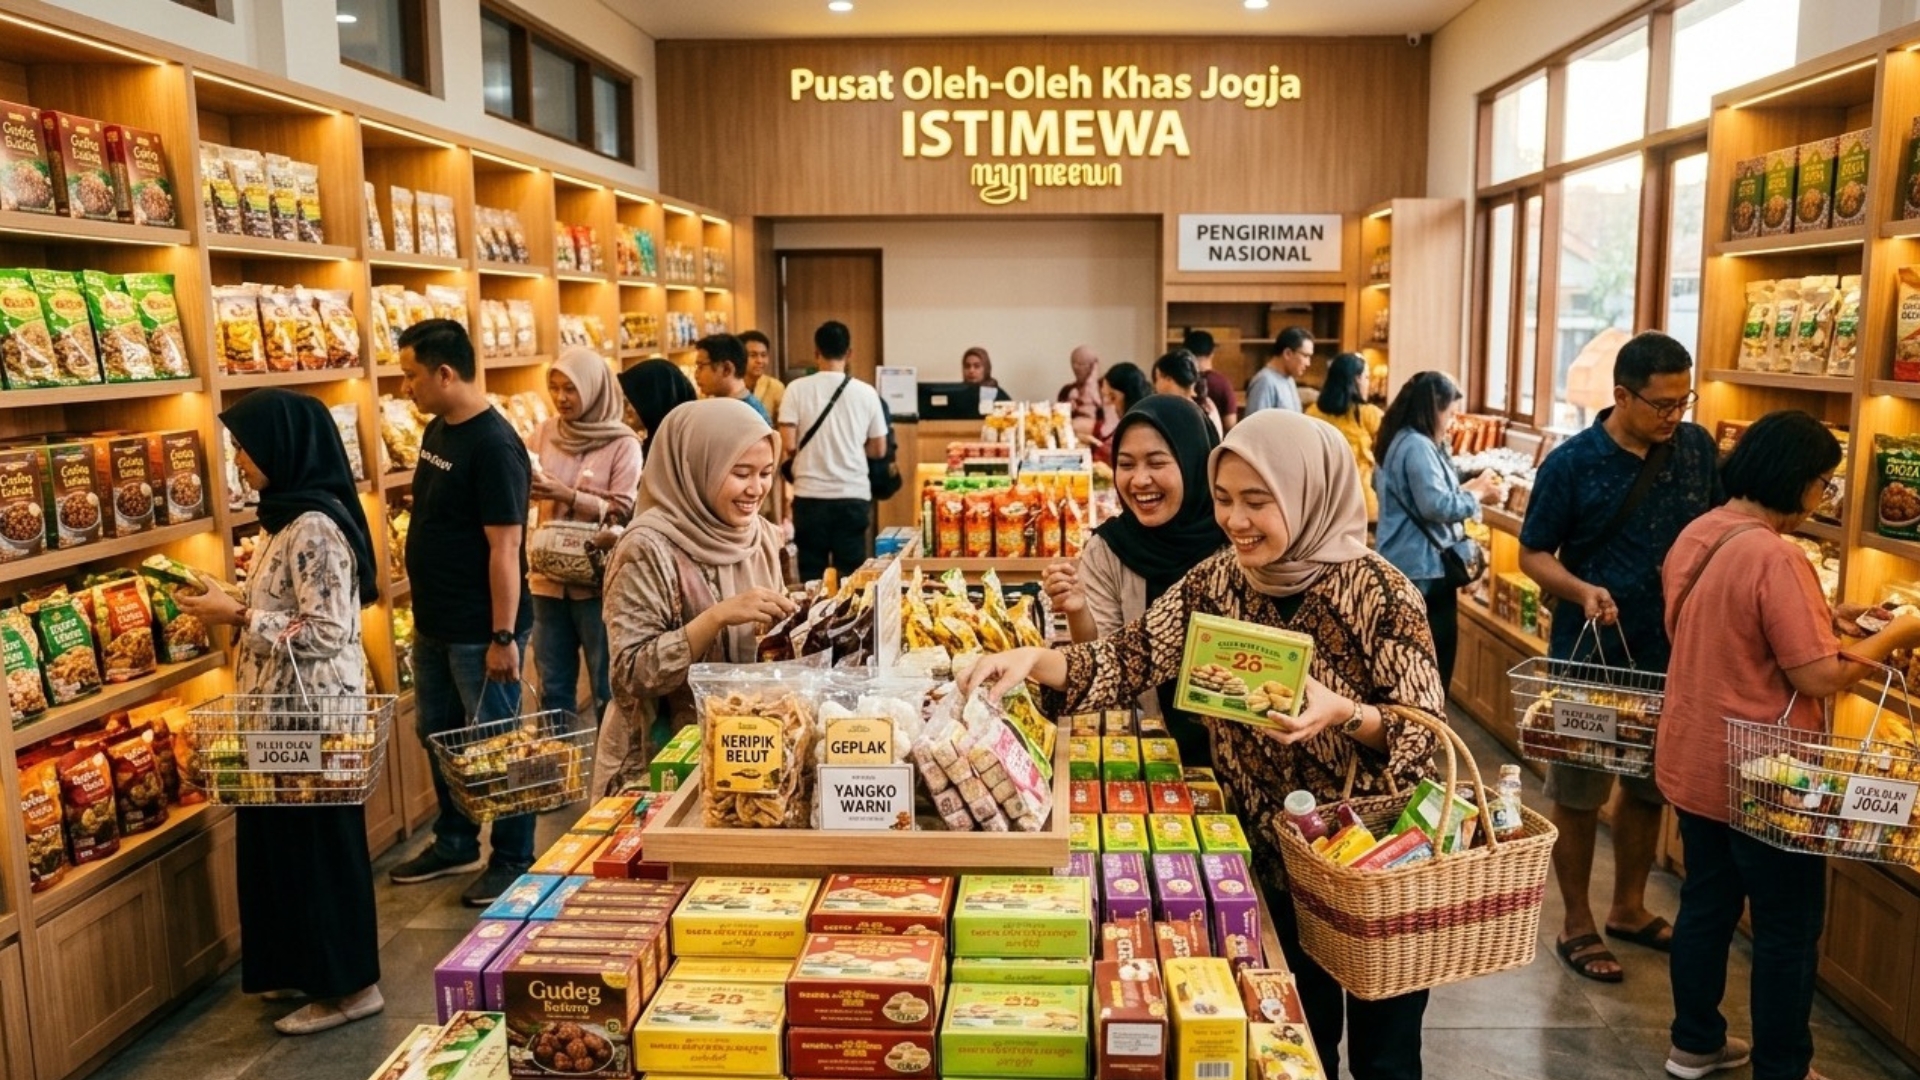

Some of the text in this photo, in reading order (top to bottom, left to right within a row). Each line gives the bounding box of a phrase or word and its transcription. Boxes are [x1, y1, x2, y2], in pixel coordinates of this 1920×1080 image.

[790, 65, 1302, 108] Pusat Oleh-Oleh Khas Jogja
[902, 109, 1191, 158] ISTIMEWA
[1196, 224, 1324, 241] PENGIRIMAN
[1208, 245, 1313, 262] NASIONAL
[721, 734, 775, 749] KERIPIK
[831, 740, 887, 754] GEPLAK
[258, 751, 310, 763] JOGJA
[726, 749, 769, 763] BELUT
[834, 784, 897, 798] YANGKO
[840, 799, 891, 813] WARNI
[527, 980, 602, 1006] Gudeg
